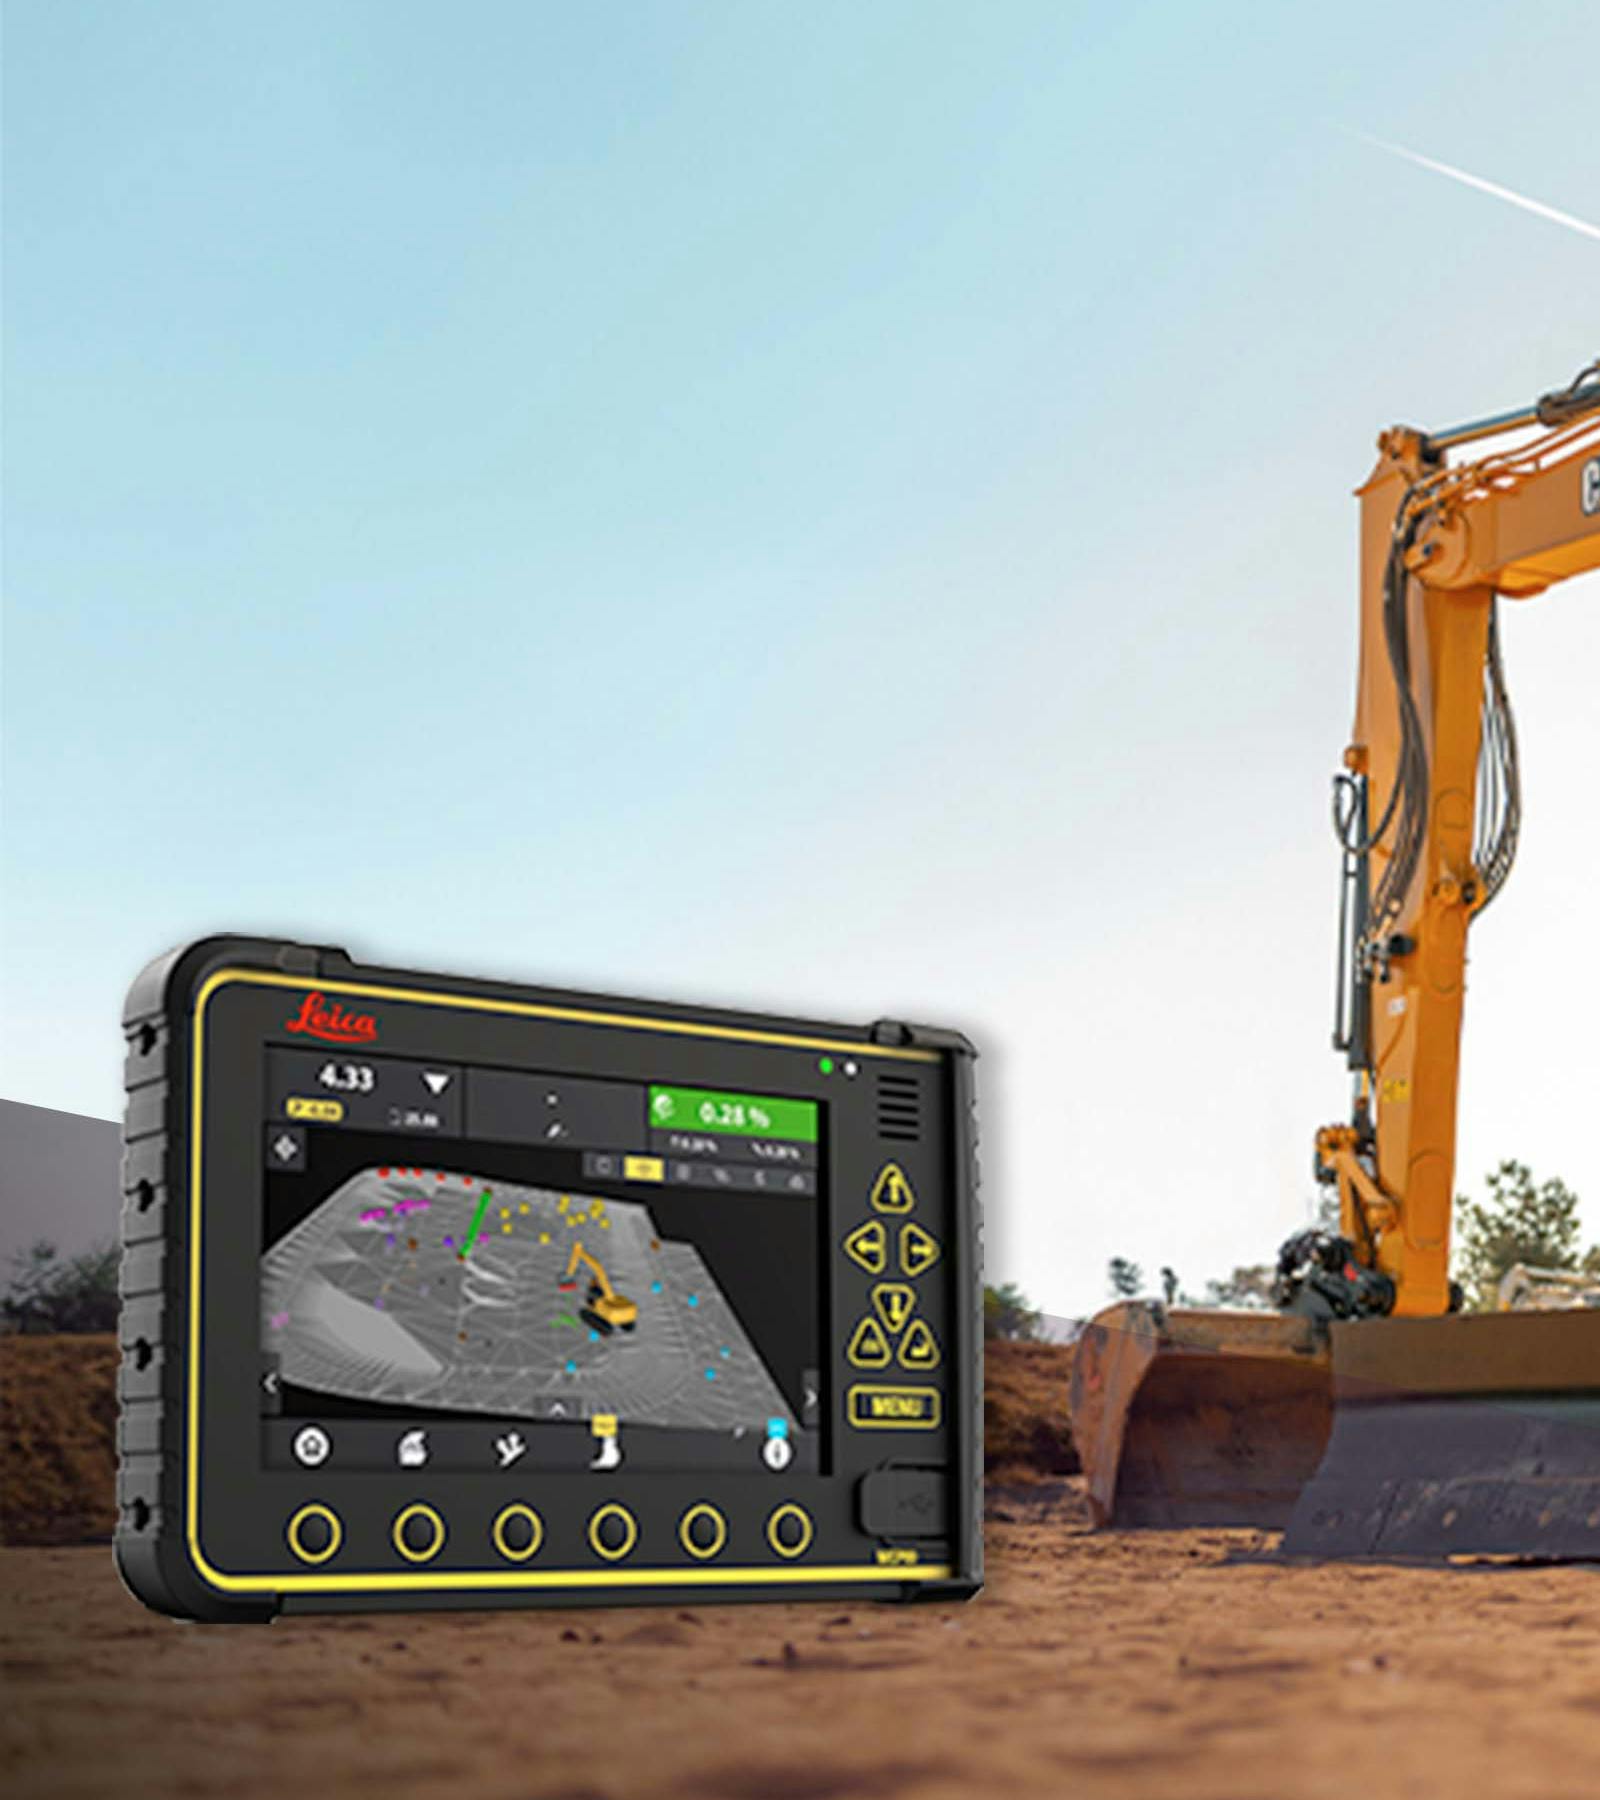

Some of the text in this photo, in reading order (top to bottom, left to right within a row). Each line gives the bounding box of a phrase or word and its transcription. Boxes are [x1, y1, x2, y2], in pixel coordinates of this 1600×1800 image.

[285, 991, 378, 1043] Leica
[319, 1063, 375, 1092] 4.33
[871, 1396, 923, 1418] MENU
